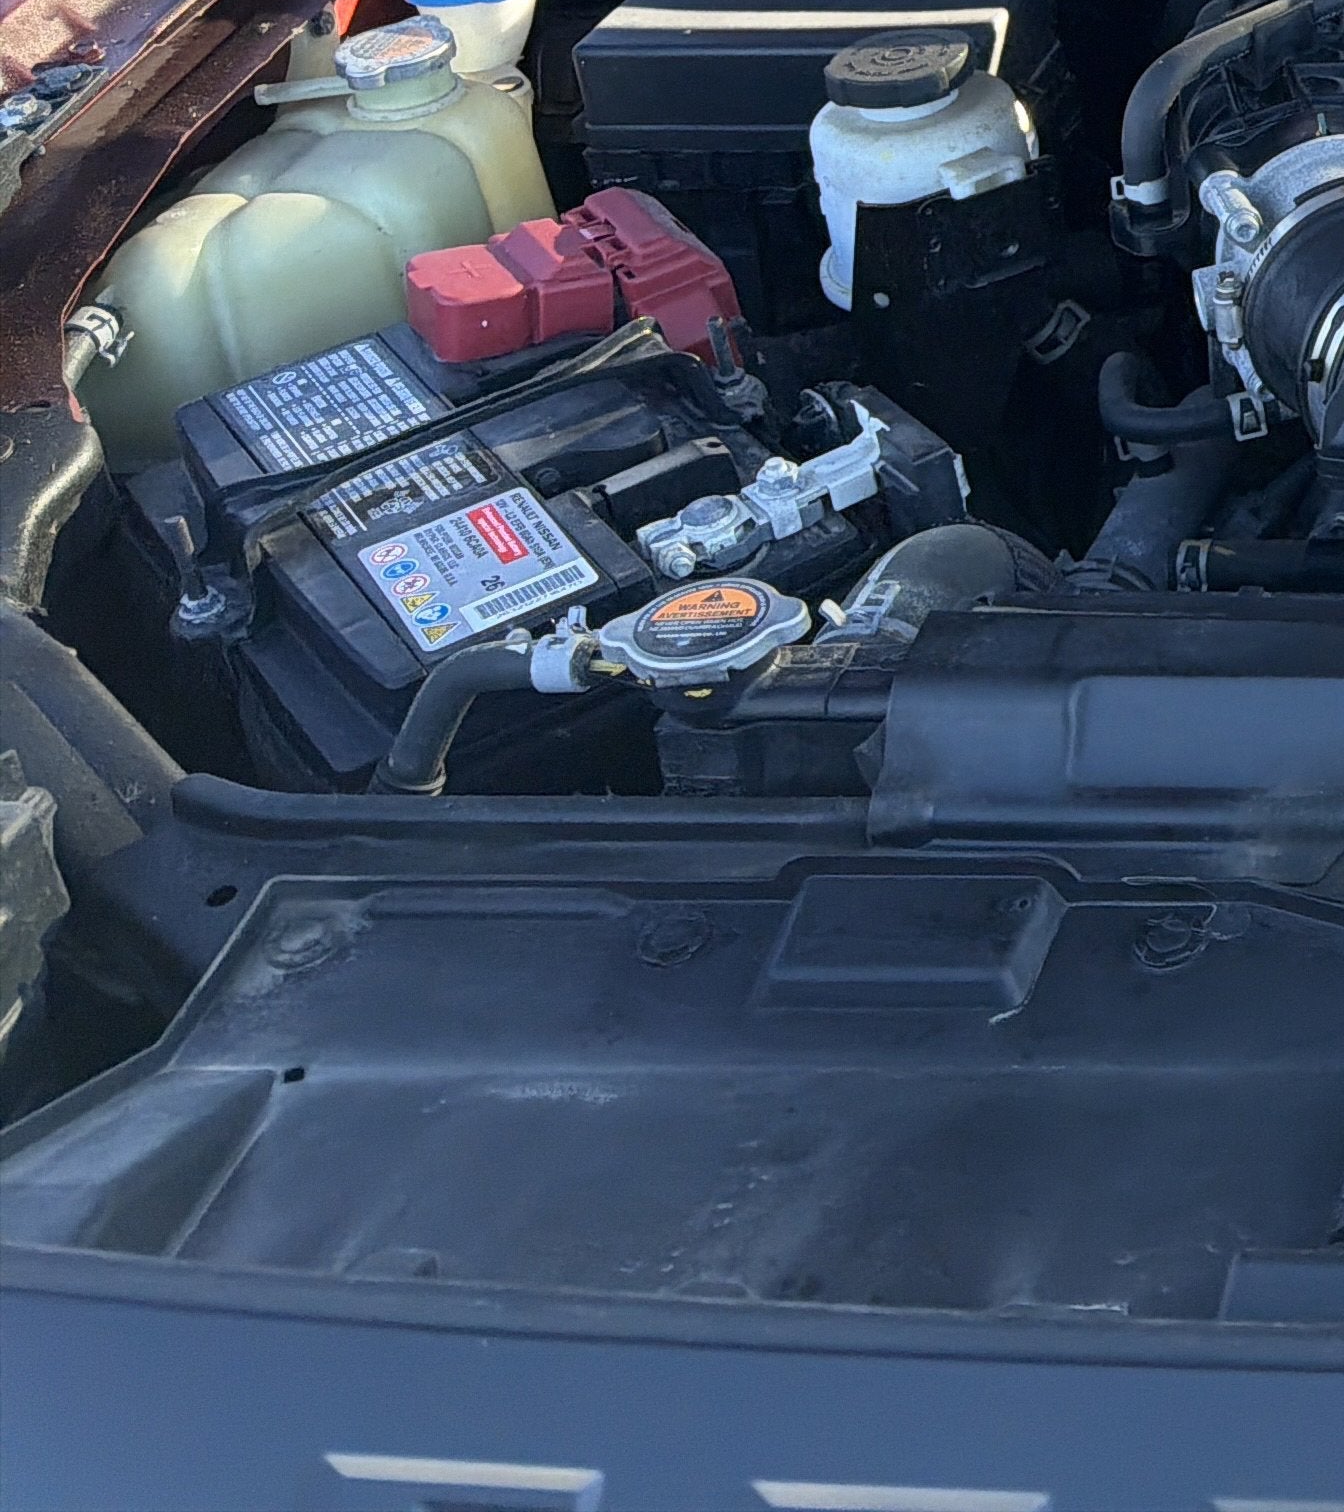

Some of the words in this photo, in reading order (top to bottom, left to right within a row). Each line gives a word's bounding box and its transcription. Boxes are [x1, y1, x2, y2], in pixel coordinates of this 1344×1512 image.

[510, 492, 540, 521] RENAULT
[532, 520, 563, 550] NISSAN
[481, 574, 506, 592] 26
[678, 602, 740, 611] WARNING
[657, 610, 752, 619] AVERTISSEMENT
